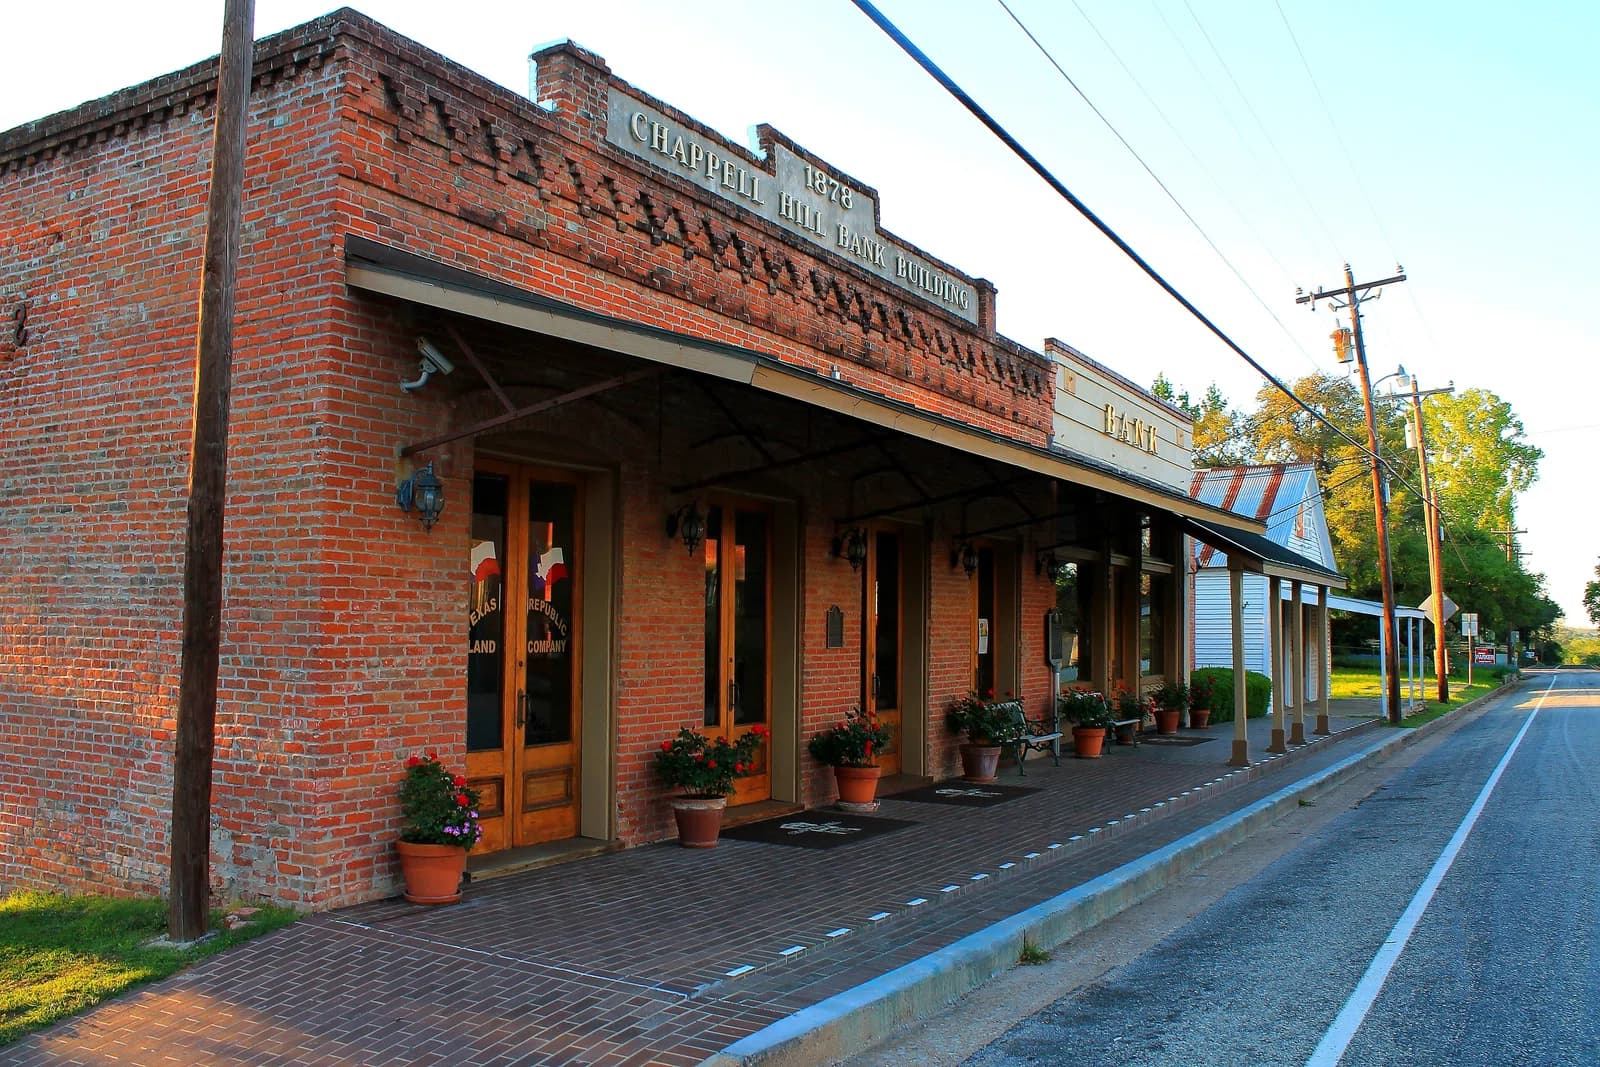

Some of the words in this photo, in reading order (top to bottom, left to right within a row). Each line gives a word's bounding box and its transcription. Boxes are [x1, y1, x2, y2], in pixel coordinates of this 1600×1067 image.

[804, 165, 854, 210] 1878
[630, 111, 765, 205] CHAPPELL
[778, 190, 827, 238] HILL
[838, 222, 887, 269] BANK
[896, 255, 970, 310] BUILDING
[1104, 404, 1159, 455] BANK
[469, 598, 497, 631] EXAS
[528, 598, 567, 636] REPUBLIC
[468, 639, 496, 654] LAND
[527, 639, 567, 653] COMPANY
